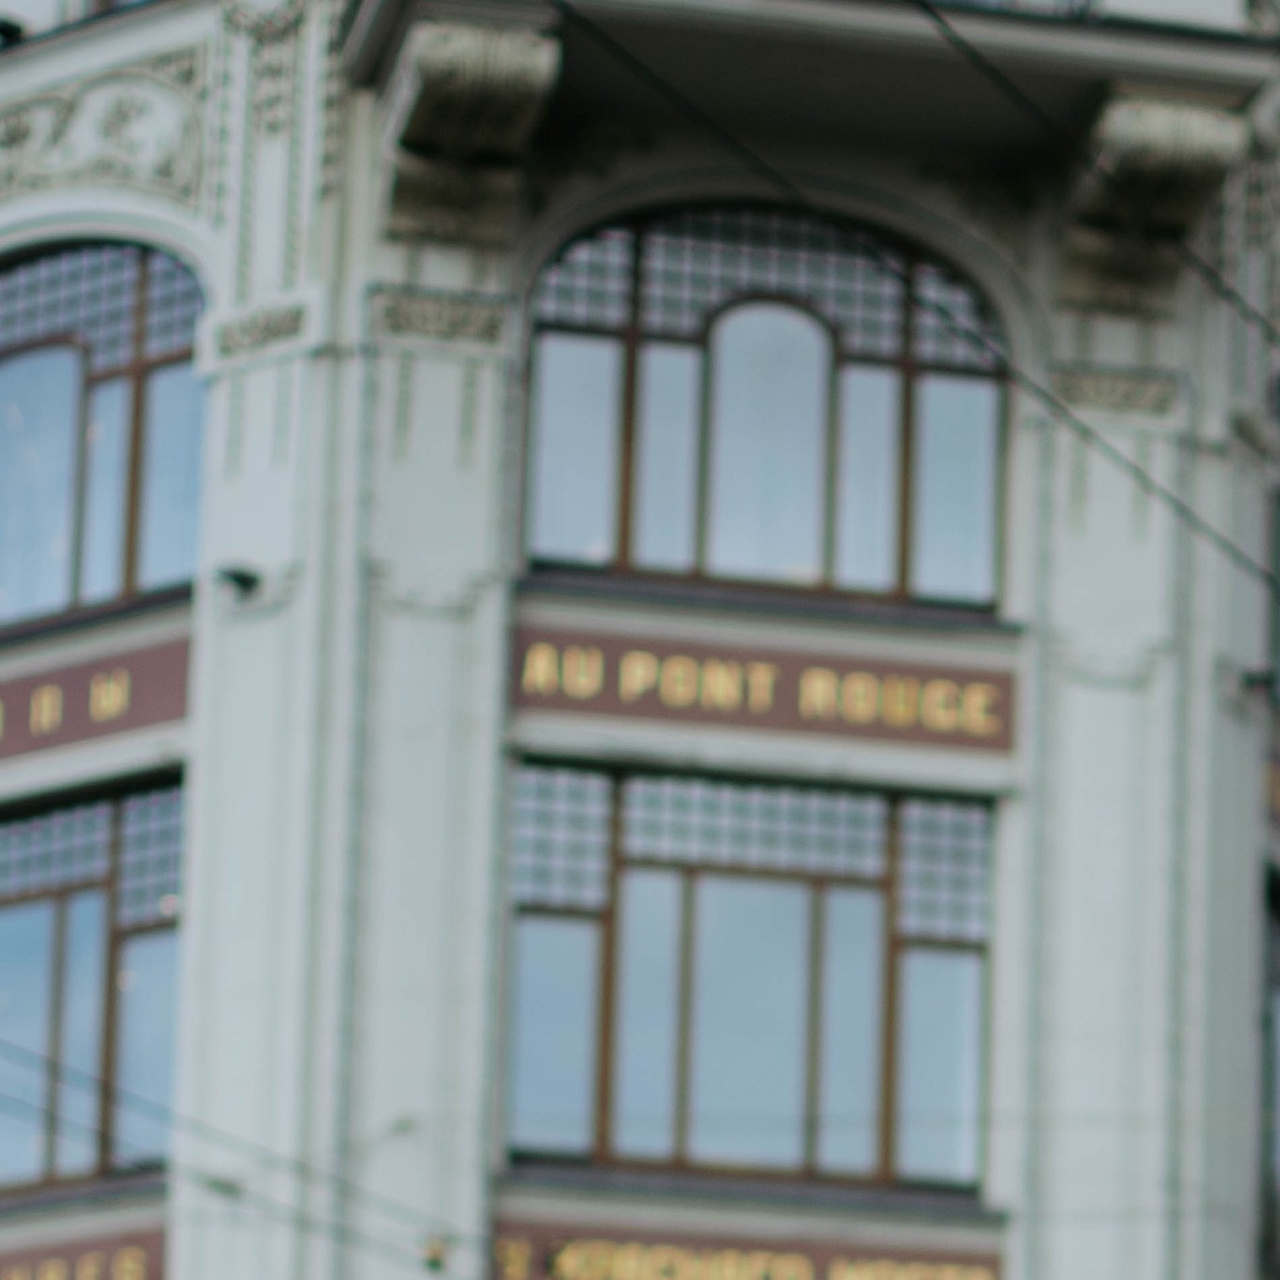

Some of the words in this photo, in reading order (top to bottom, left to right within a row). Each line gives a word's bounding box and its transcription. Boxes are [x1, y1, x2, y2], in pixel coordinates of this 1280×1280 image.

[522, 641, 605, 700] AU
[618, 650, 776, 715] PONT
[800, 666, 1001, 736] ROUGE
